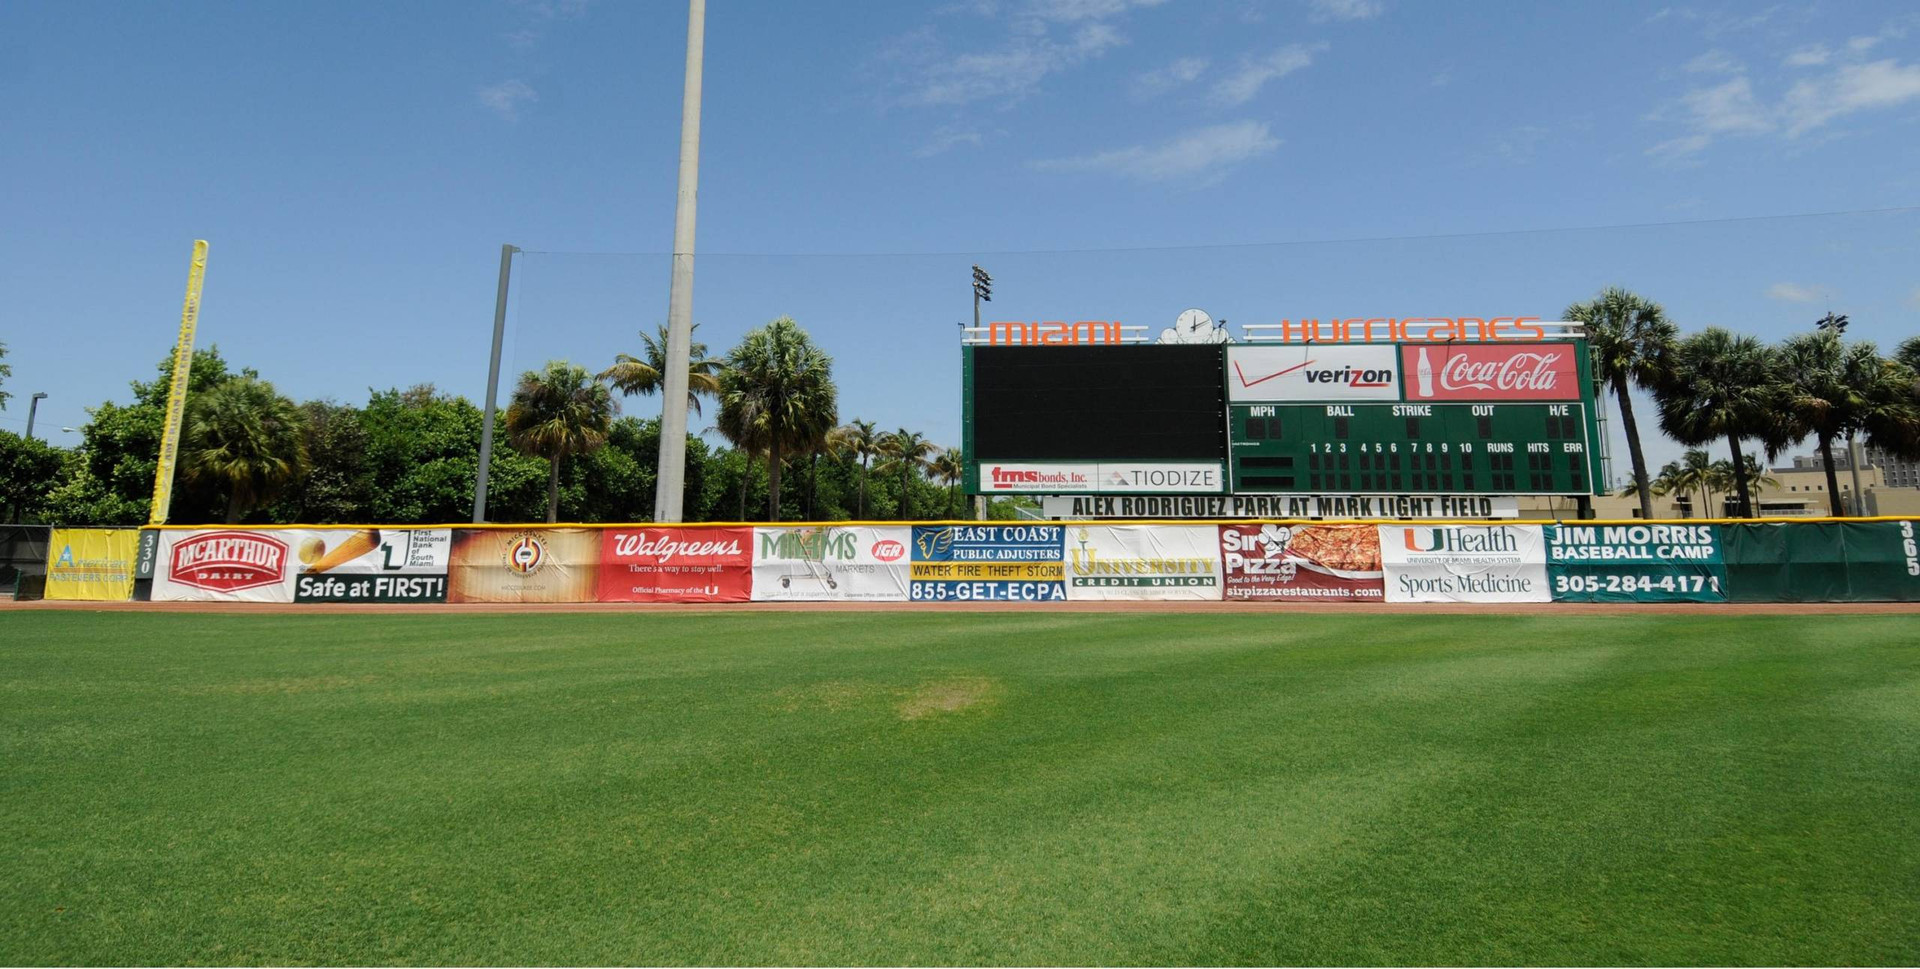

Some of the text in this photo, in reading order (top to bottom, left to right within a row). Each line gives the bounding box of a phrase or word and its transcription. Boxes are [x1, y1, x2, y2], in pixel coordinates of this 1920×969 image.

[1306, 366, 1392, 387] verizon
[1440, 352, 1562, 391] Coca-Cola
[1250, 406, 1276, 417] MPH
[1326, 406, 1355, 417] BALL
[1392, 405, 1432, 417] STRIKE
[1471, 405, 1495, 416] OUT
[1549, 405, 1569, 416] H/E
[1310, 443, 1583, 453] 1 2 3 4 5 6 7 8 9 10 RUNS HITS ERR
[1071, 471, 1088, 483] Inc.
[1130, 470, 1214, 486] TIODIZE
[1072, 497, 1492, 516] ALEX RODRIGUEZ PARK AT MARK LIGHT FIELD
[953, 526, 1061, 542] EAST COAST
[1222, 529, 1260, 551] Sir
[1551, 526, 1712, 545] JIM MORRIS
[141, 535, 154, 573] 330
[614, 532, 743, 563] Walgreens
[875, 544, 901, 557] IGA
[1552, 546, 1714, 559] BASEBALL CAMP
[1899, 520, 1920, 576] 365
[953, 549, 1061, 560] PUBLIC ADJUSTERS
[629, 564, 657, 573] There's
[665, 567, 680, 575] way
[682, 565, 689, 573] to
[691, 565, 706, 575] stay
[708, 564, 724, 573] well.
[836, 564, 875, 574] MARKETS
[1225, 553, 1297, 574] Pizza
[197, 572, 255, 580] DAIRY
[913, 565, 1063, 576] WATER FIRE THEFT STORM
[1075, 578, 1214, 586] CREDIT UNION
[1227, 576, 1243, 584] Good
[1261, 575, 1276, 584] Very
[1277, 574, 1295, 583] Edge!
[1399, 573, 1532, 598] Sports Medicine
[1556, 575, 1719, 592] 305-284-4171
[299, 577, 444, 598] Safe at FIRST!
[632, 585, 719, 596] Official Pharmacy of the U
[911, 582, 1065, 600] 855-GET-ECPA
[1227, 585, 1382, 598] sirpizzarestaurants.com
